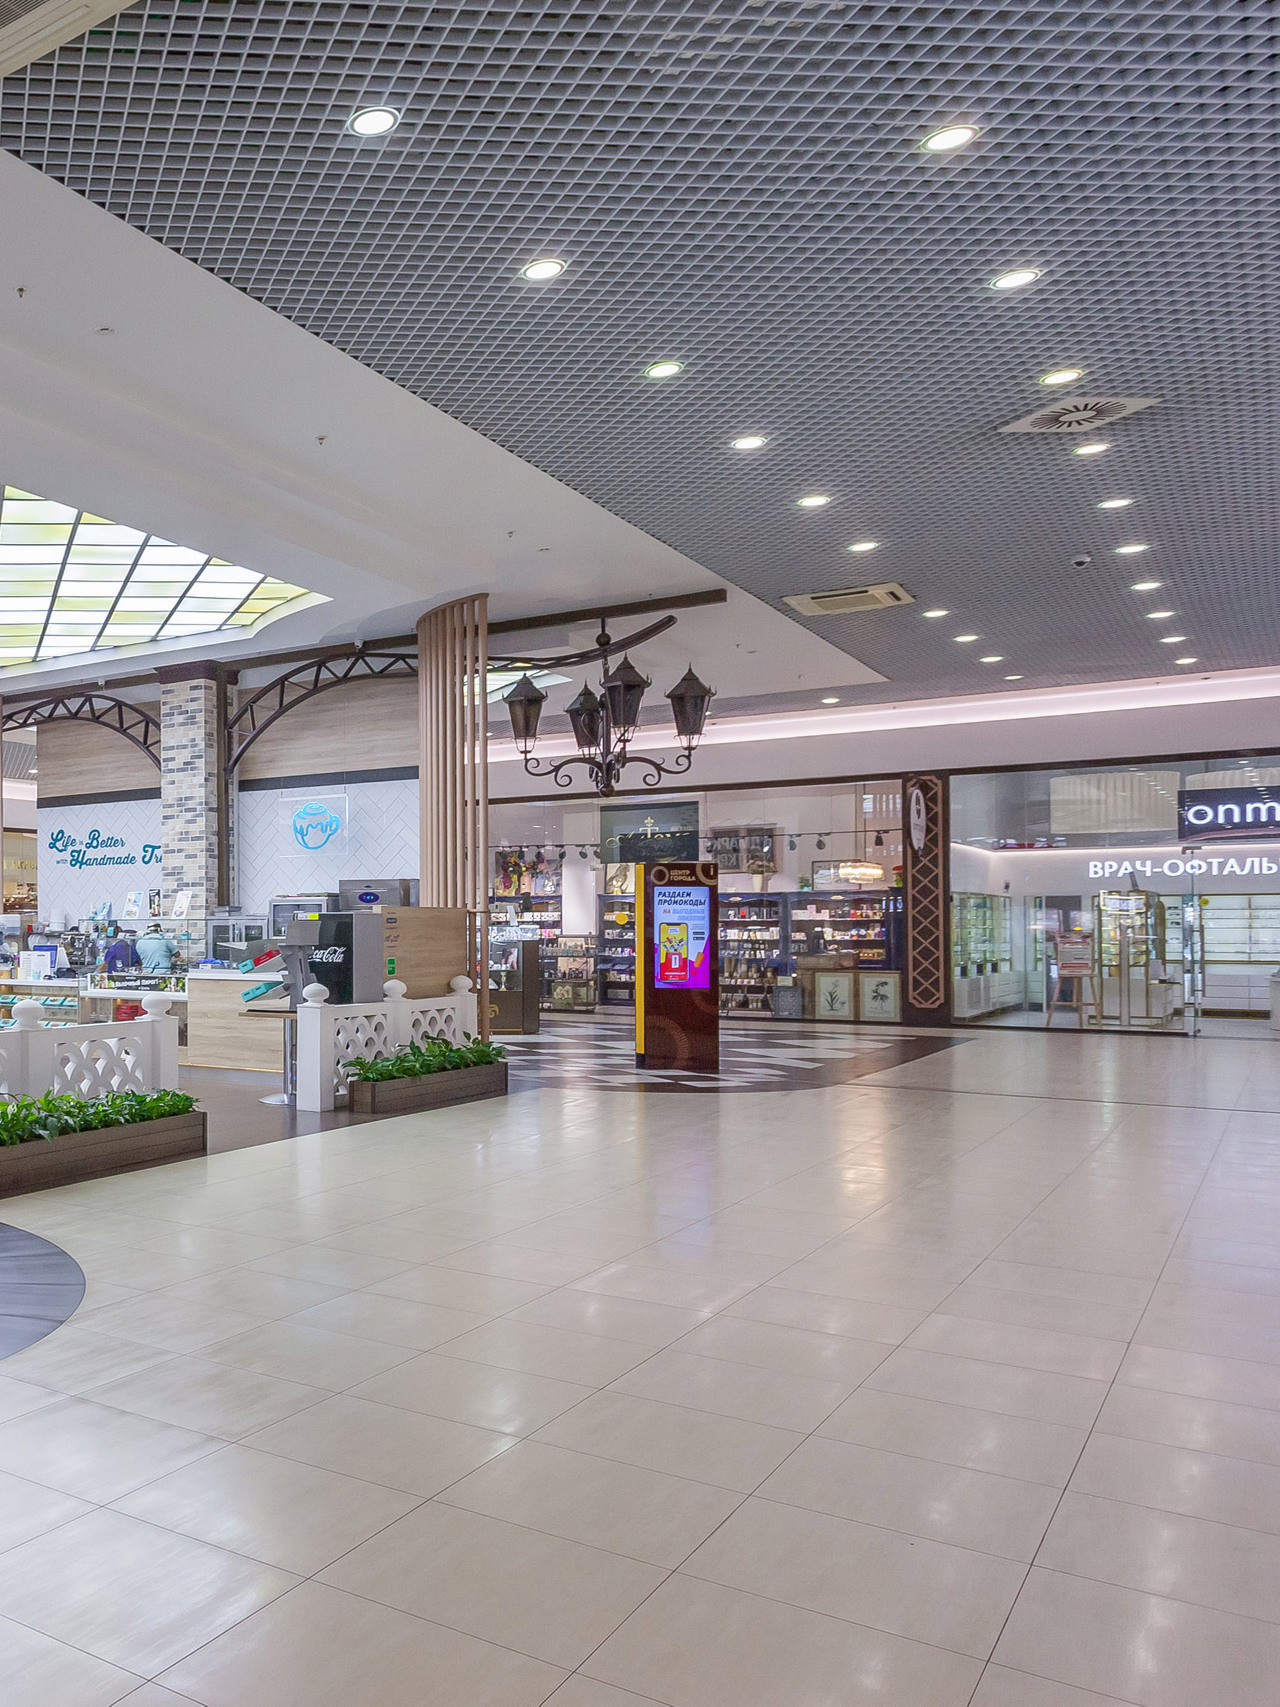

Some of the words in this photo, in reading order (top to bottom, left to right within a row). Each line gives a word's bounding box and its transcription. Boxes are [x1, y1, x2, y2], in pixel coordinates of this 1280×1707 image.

[48, 829, 78, 853] Life
[84, 829, 126, 849] Better
[69, 849, 138, 870] Handmade
[657, 891, 692, 899] РАЗДАЕМ
[657, 899, 706, 907] ПРОМОКОДЫ
